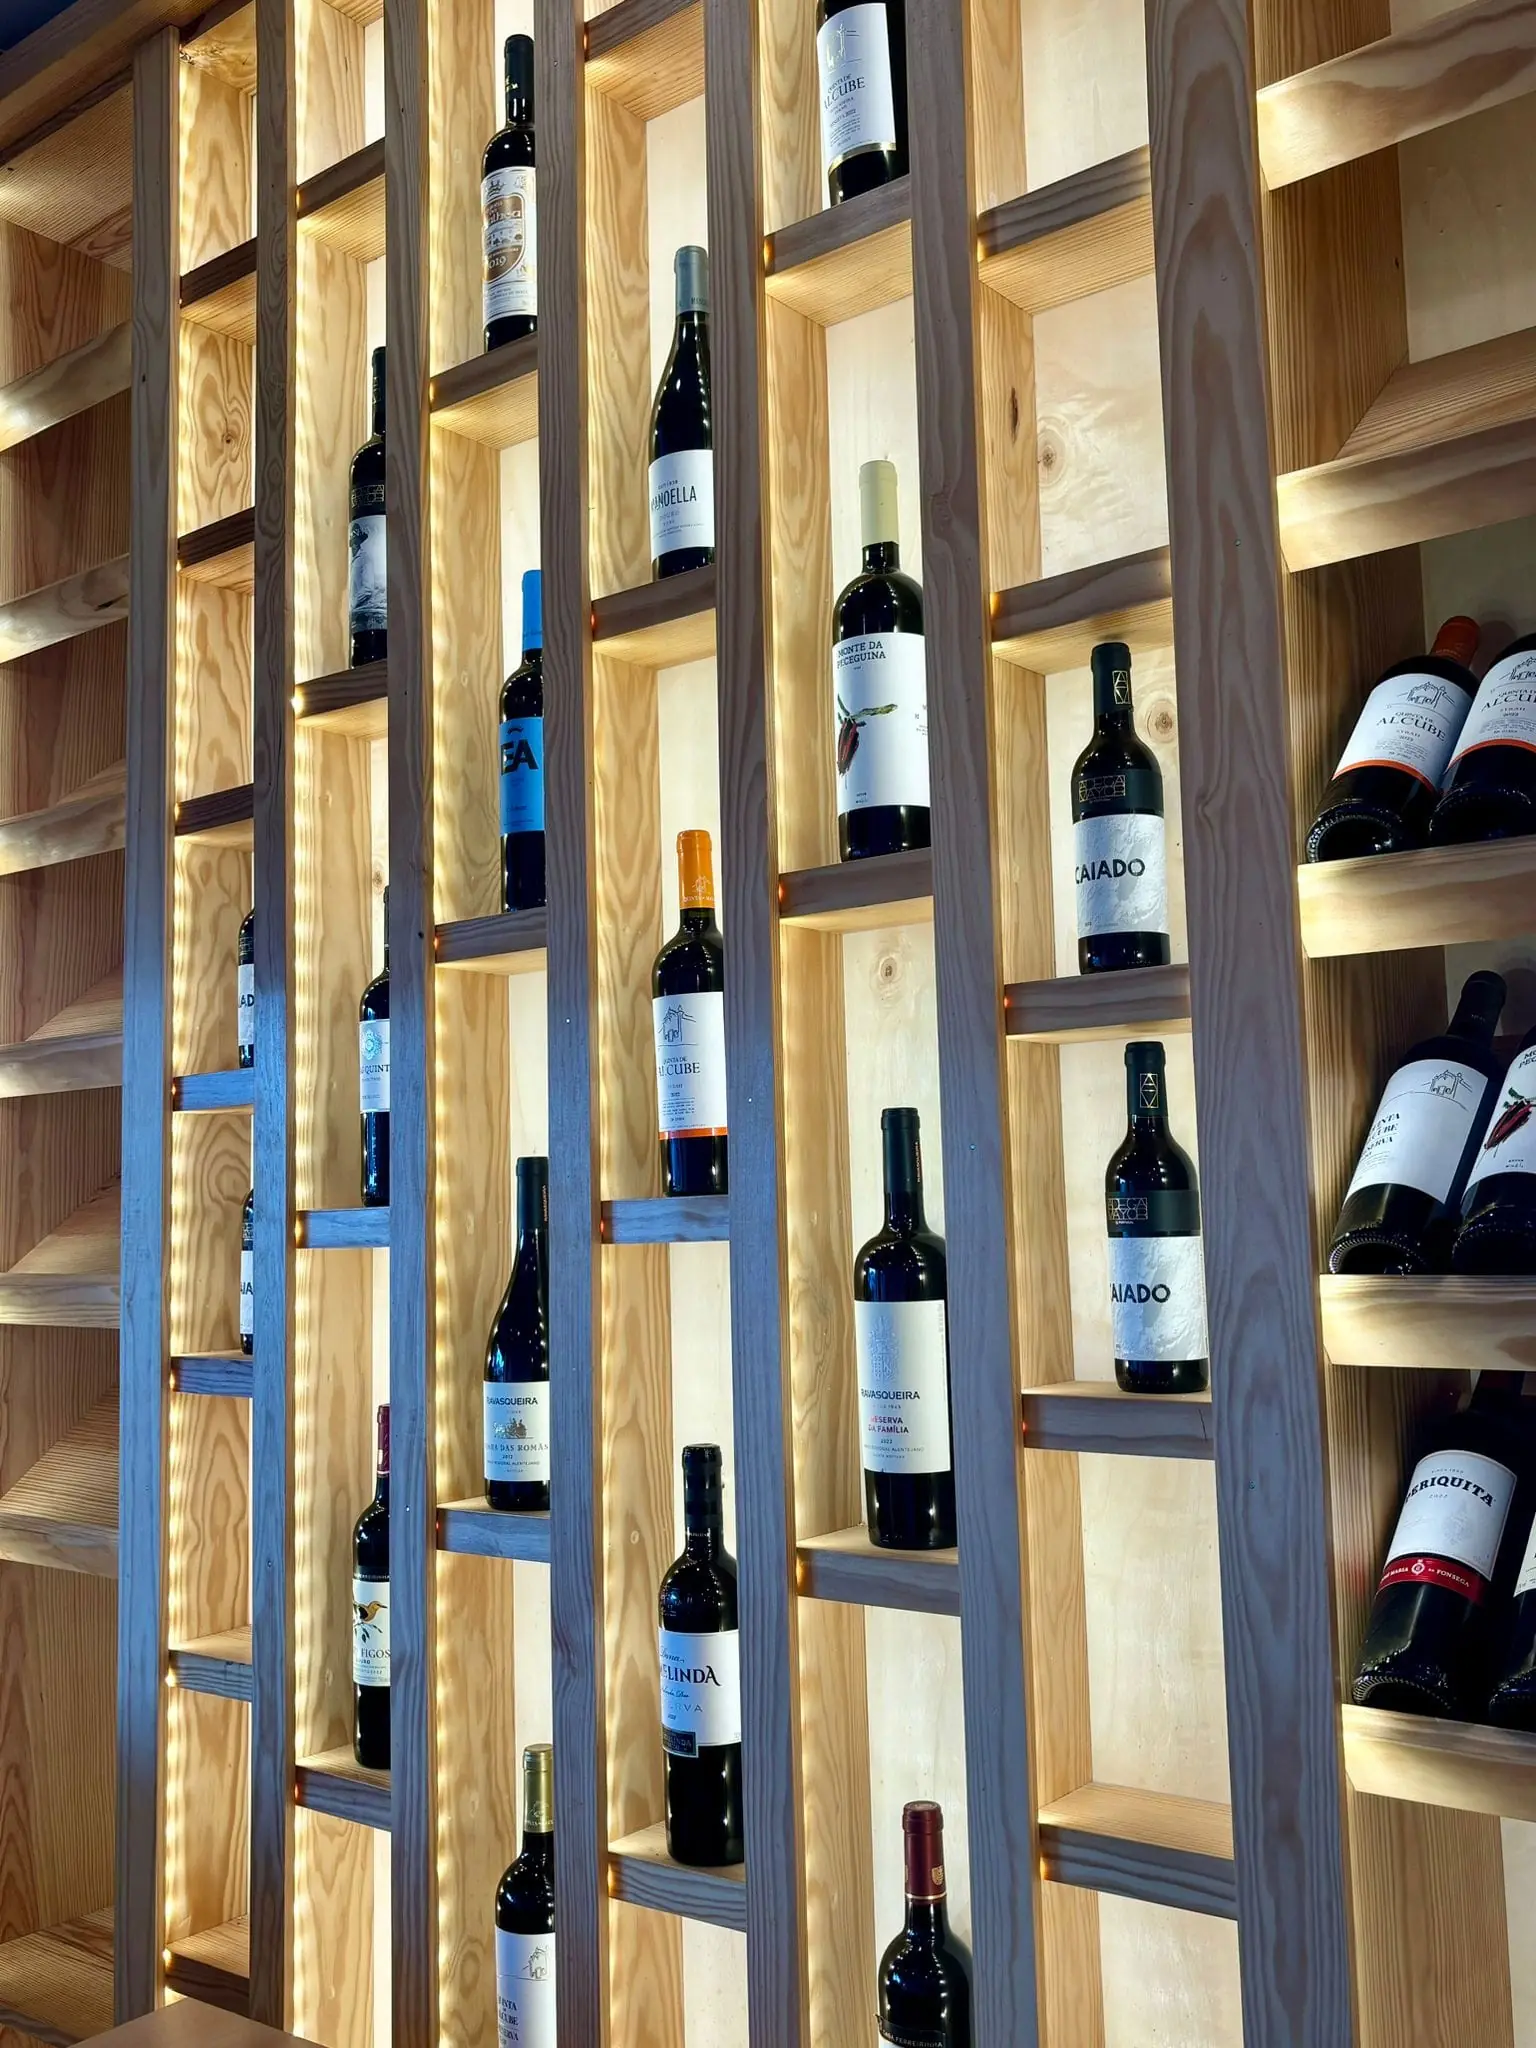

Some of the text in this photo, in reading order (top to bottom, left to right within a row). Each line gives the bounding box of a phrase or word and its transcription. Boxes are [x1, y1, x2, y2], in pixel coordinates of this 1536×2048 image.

[869, 640, 884, 650] DA
[837, 650, 887, 669] PECEGUINA
[1376, 716, 1447, 742] ALCUBE
[501, 739, 539, 776] EA
[1075, 858, 1146, 885] CAIADO
[1110, 1283, 1171, 1304] AIADO
[860, 1388, 921, 1400] RAVASQUEIRA
[871, 1415, 904, 1424] RESERVA
[877, 1425, 910, 1434] FAMÍLIA
[1405, 1475, 1493, 1507] PERIQUITA
